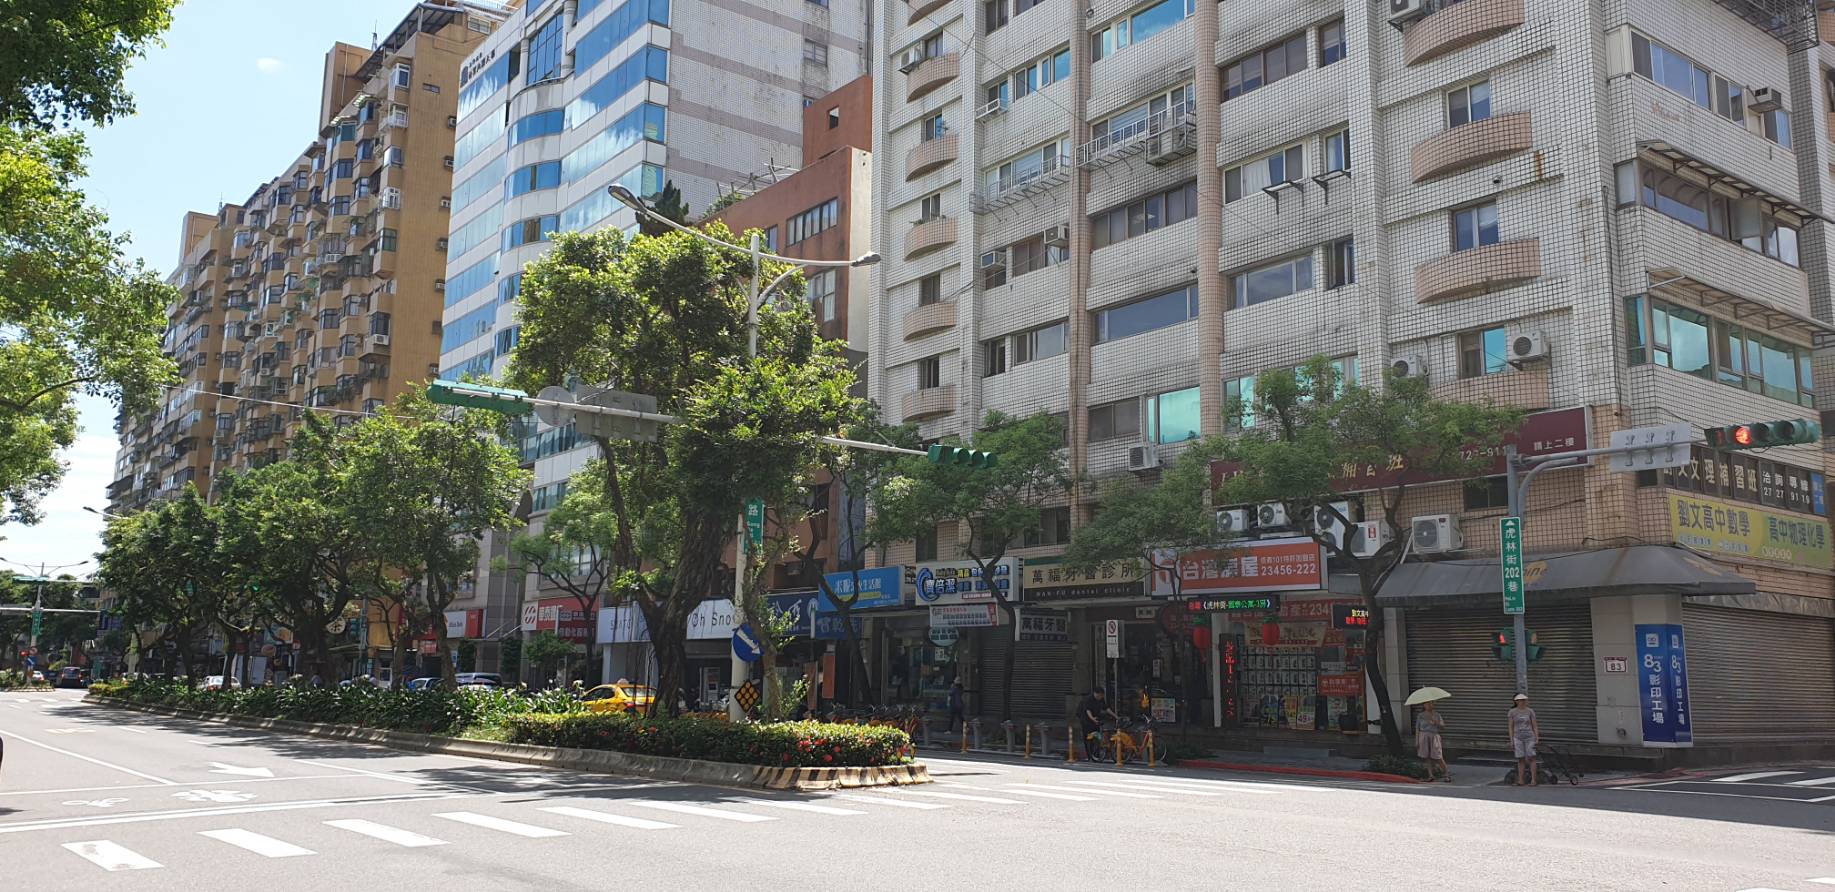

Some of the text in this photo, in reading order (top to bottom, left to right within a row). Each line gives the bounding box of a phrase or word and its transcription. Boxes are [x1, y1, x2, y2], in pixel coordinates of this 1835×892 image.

[1677, 499, 1750, 537] 劉文高中數學
[1261, 563, 1316, 577] 23456-222
[1644, 653, 1661, 673] 83
